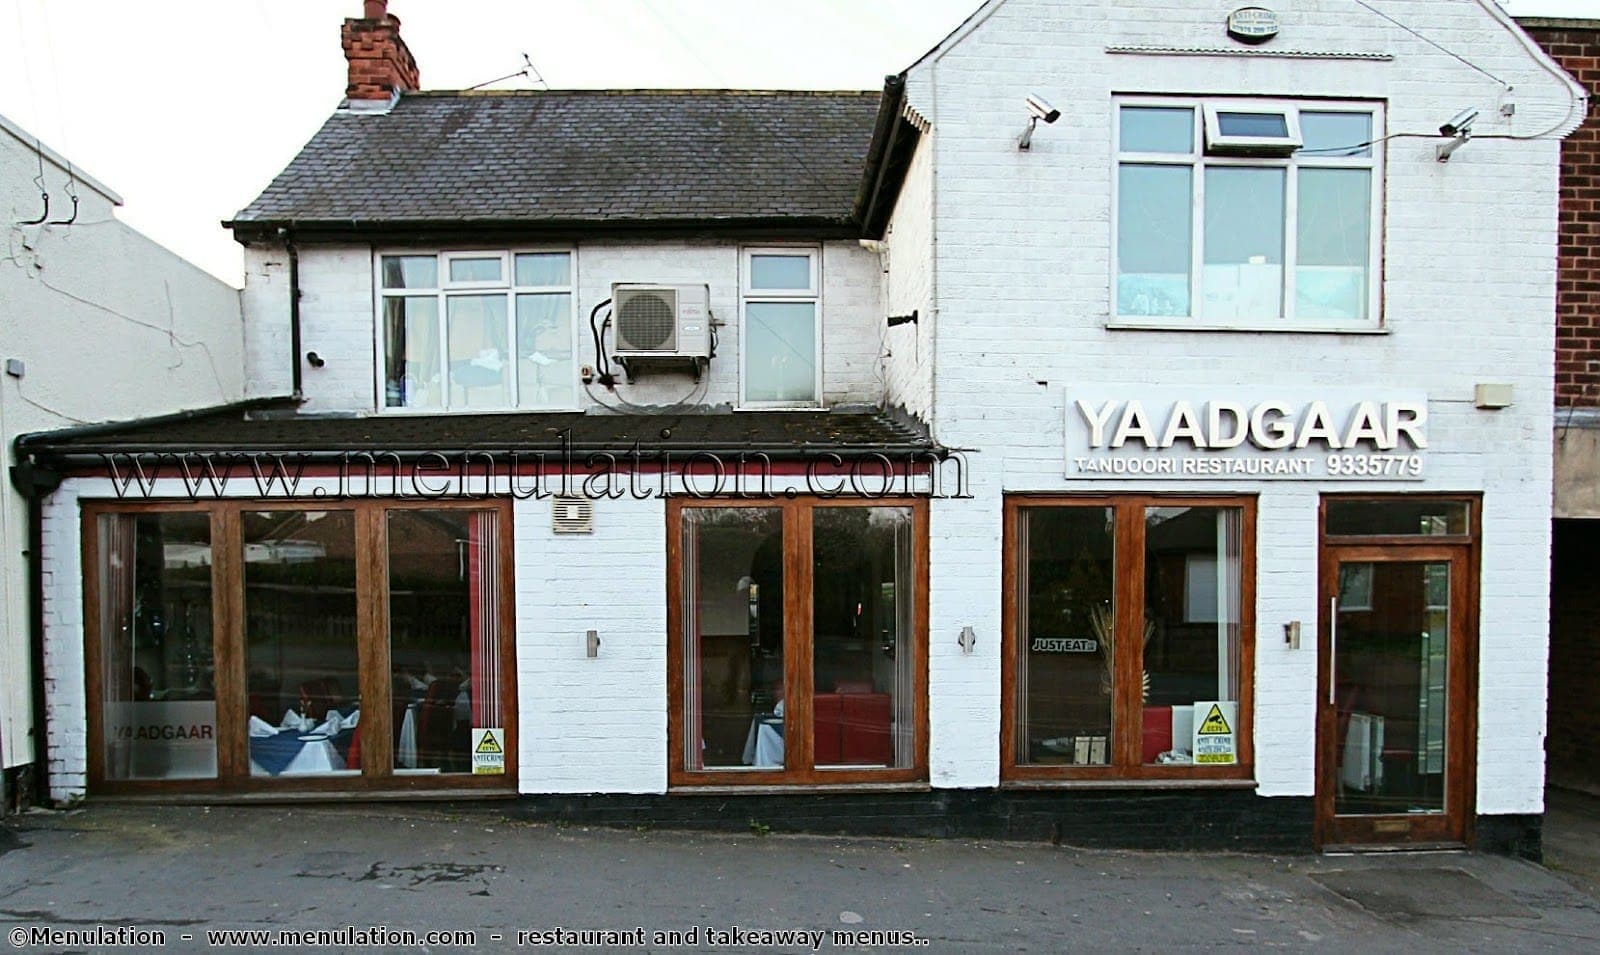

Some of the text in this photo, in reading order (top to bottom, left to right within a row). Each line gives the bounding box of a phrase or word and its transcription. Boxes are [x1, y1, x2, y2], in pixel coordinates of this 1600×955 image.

[1073, 399, 1430, 450] YAADGAAR
[1075, 454, 1424, 476] TANDOORI RESTAURANT 9335779
[113, 724, 213, 740] YAADGAAR
